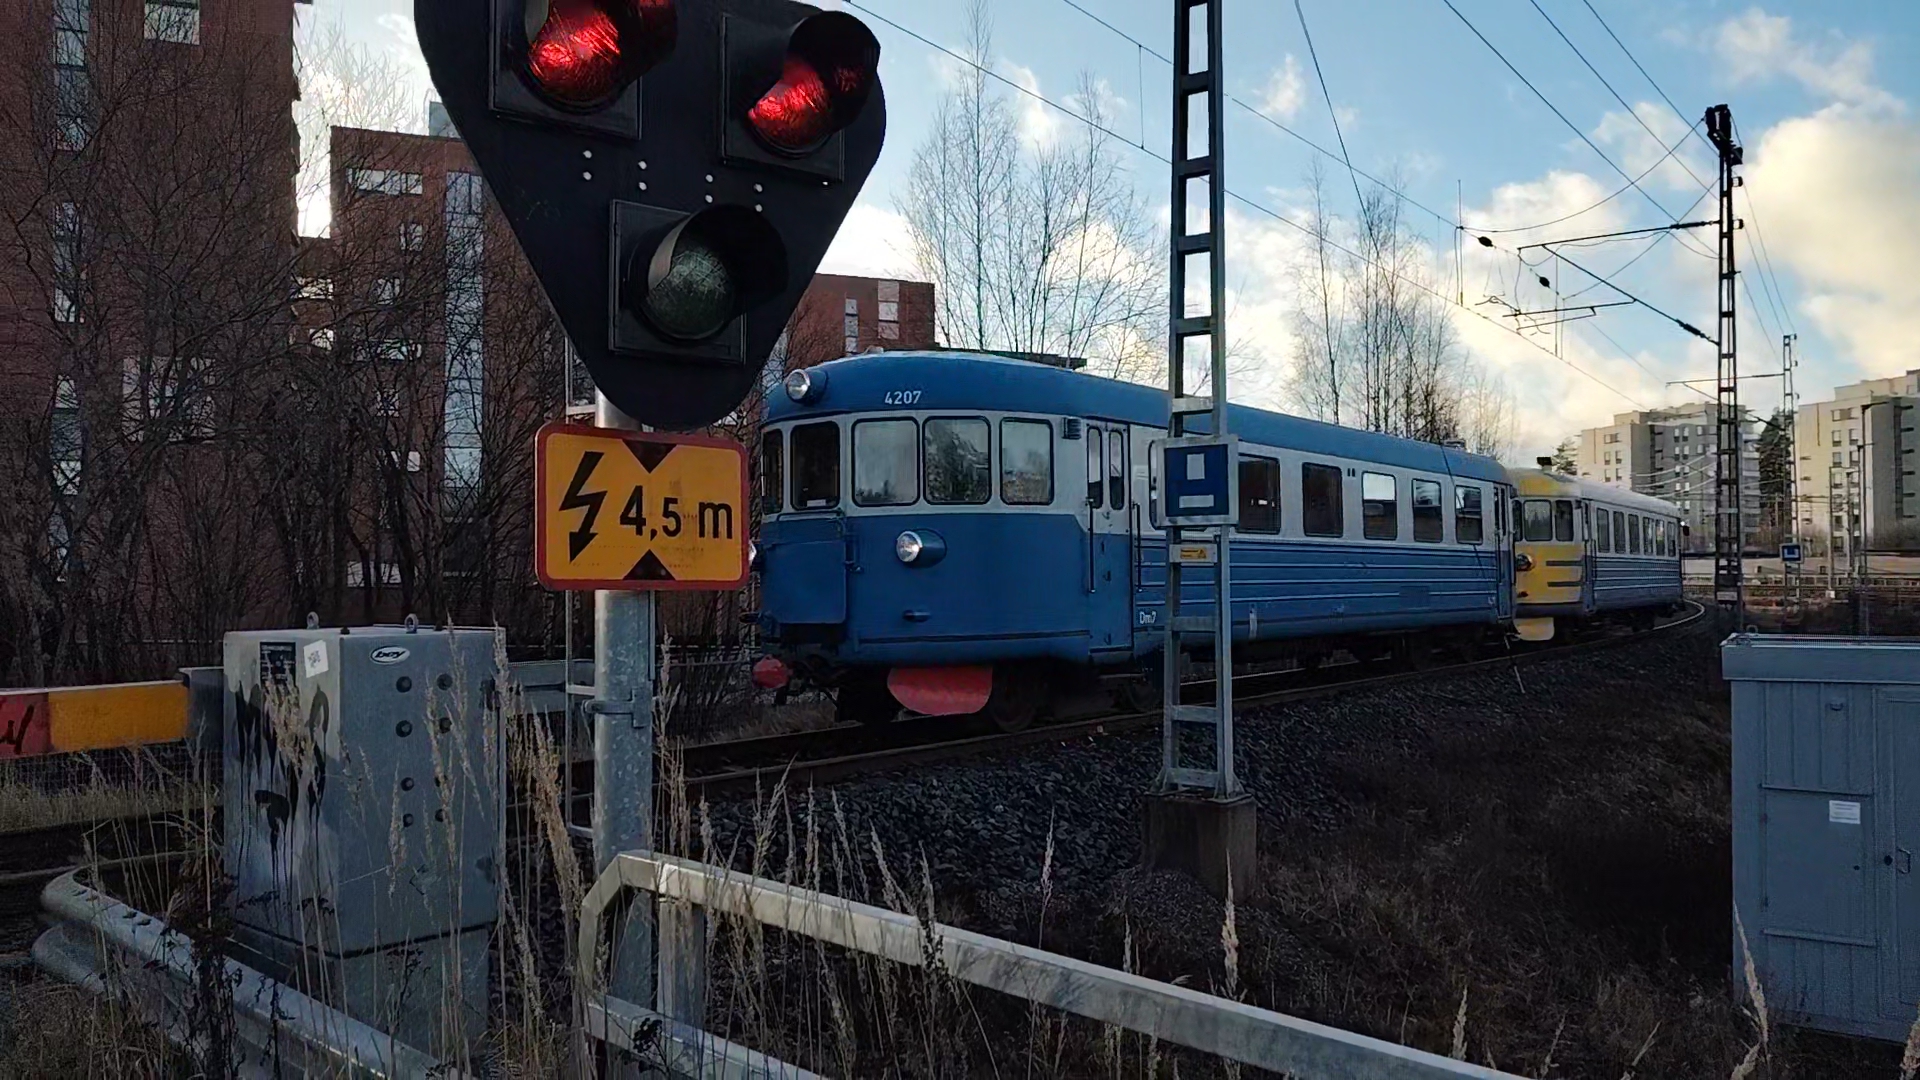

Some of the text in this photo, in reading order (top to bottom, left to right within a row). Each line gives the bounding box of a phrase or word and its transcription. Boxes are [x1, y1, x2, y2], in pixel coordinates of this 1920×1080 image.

[884, 390, 922, 405] 4207
[619, 485, 733, 541] 4,5 m
